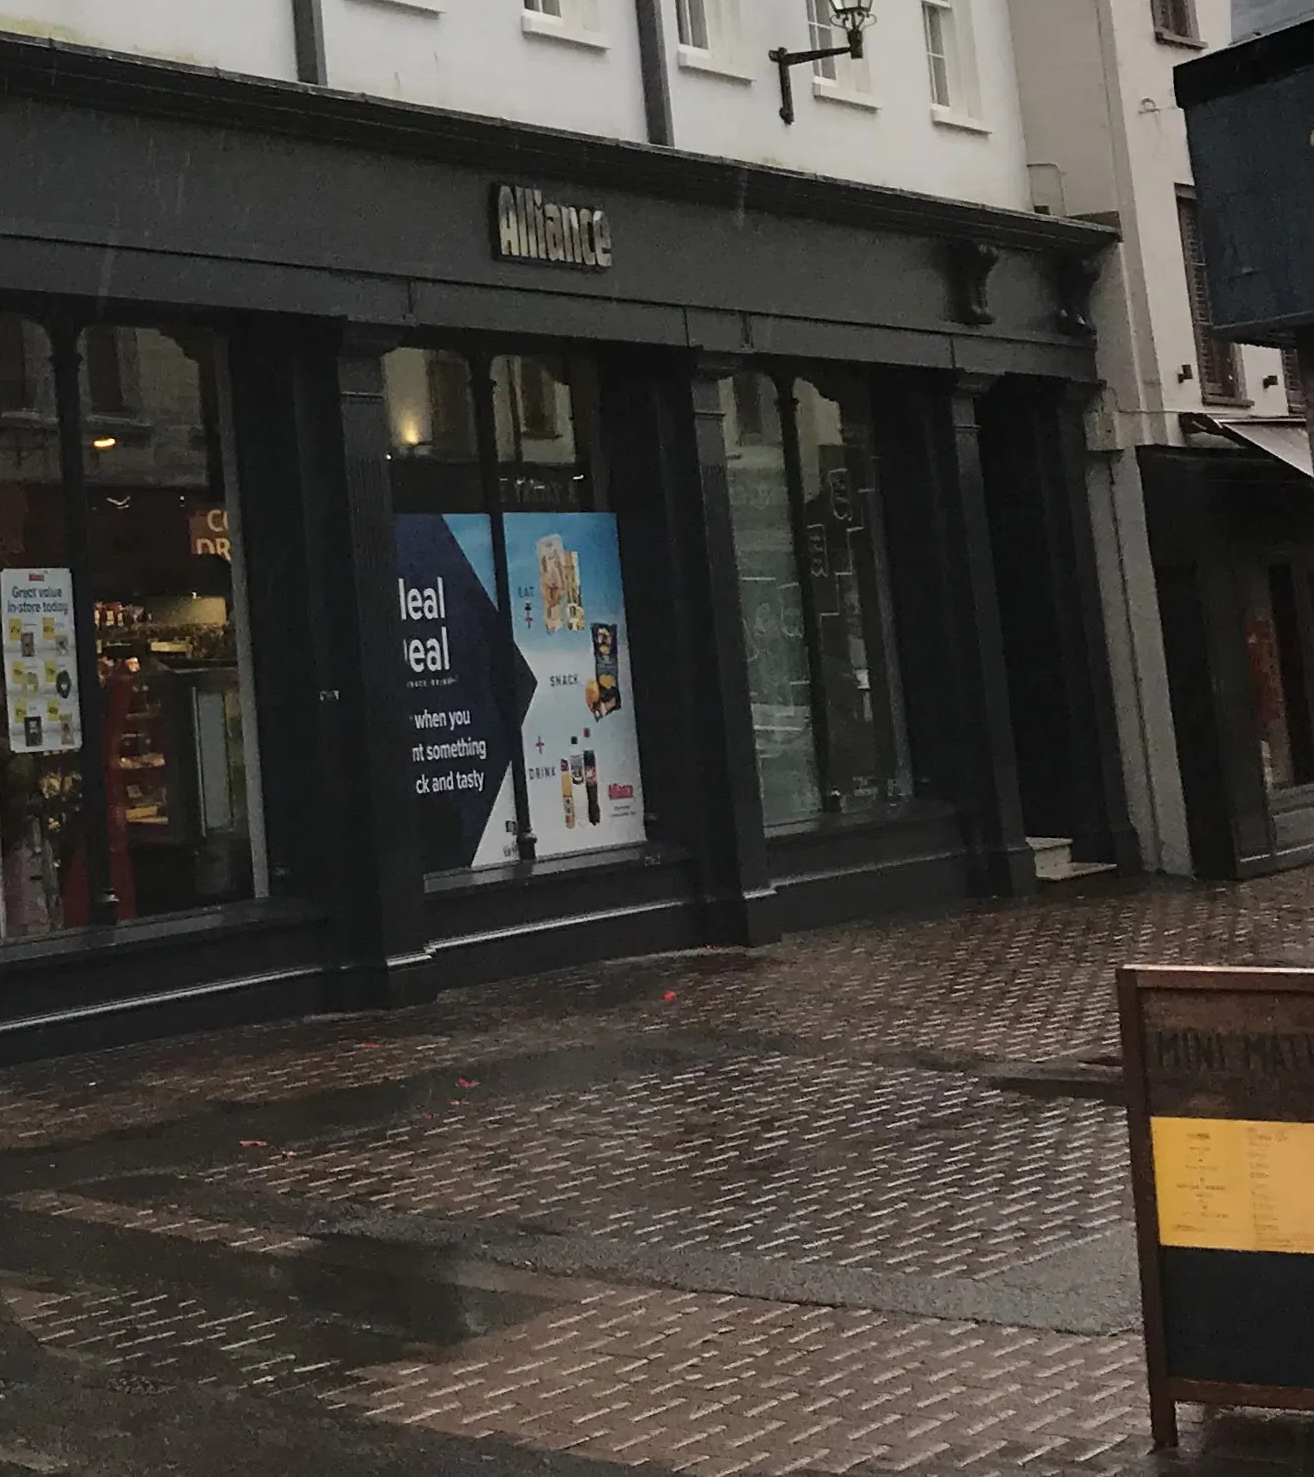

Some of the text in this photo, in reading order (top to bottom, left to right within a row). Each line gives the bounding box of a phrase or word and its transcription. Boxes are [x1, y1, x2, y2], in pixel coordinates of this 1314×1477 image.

[497, 184, 613, 267] Alliance
[403, 625, 451, 673] eal
[549, 674, 580, 687] SNACK
[414, 708, 471, 731] when you
[426, 738, 487, 762] something
[431, 774, 455, 792] and
[456, 770, 485, 793] tasty
[528, 767, 557, 780] DRINK
